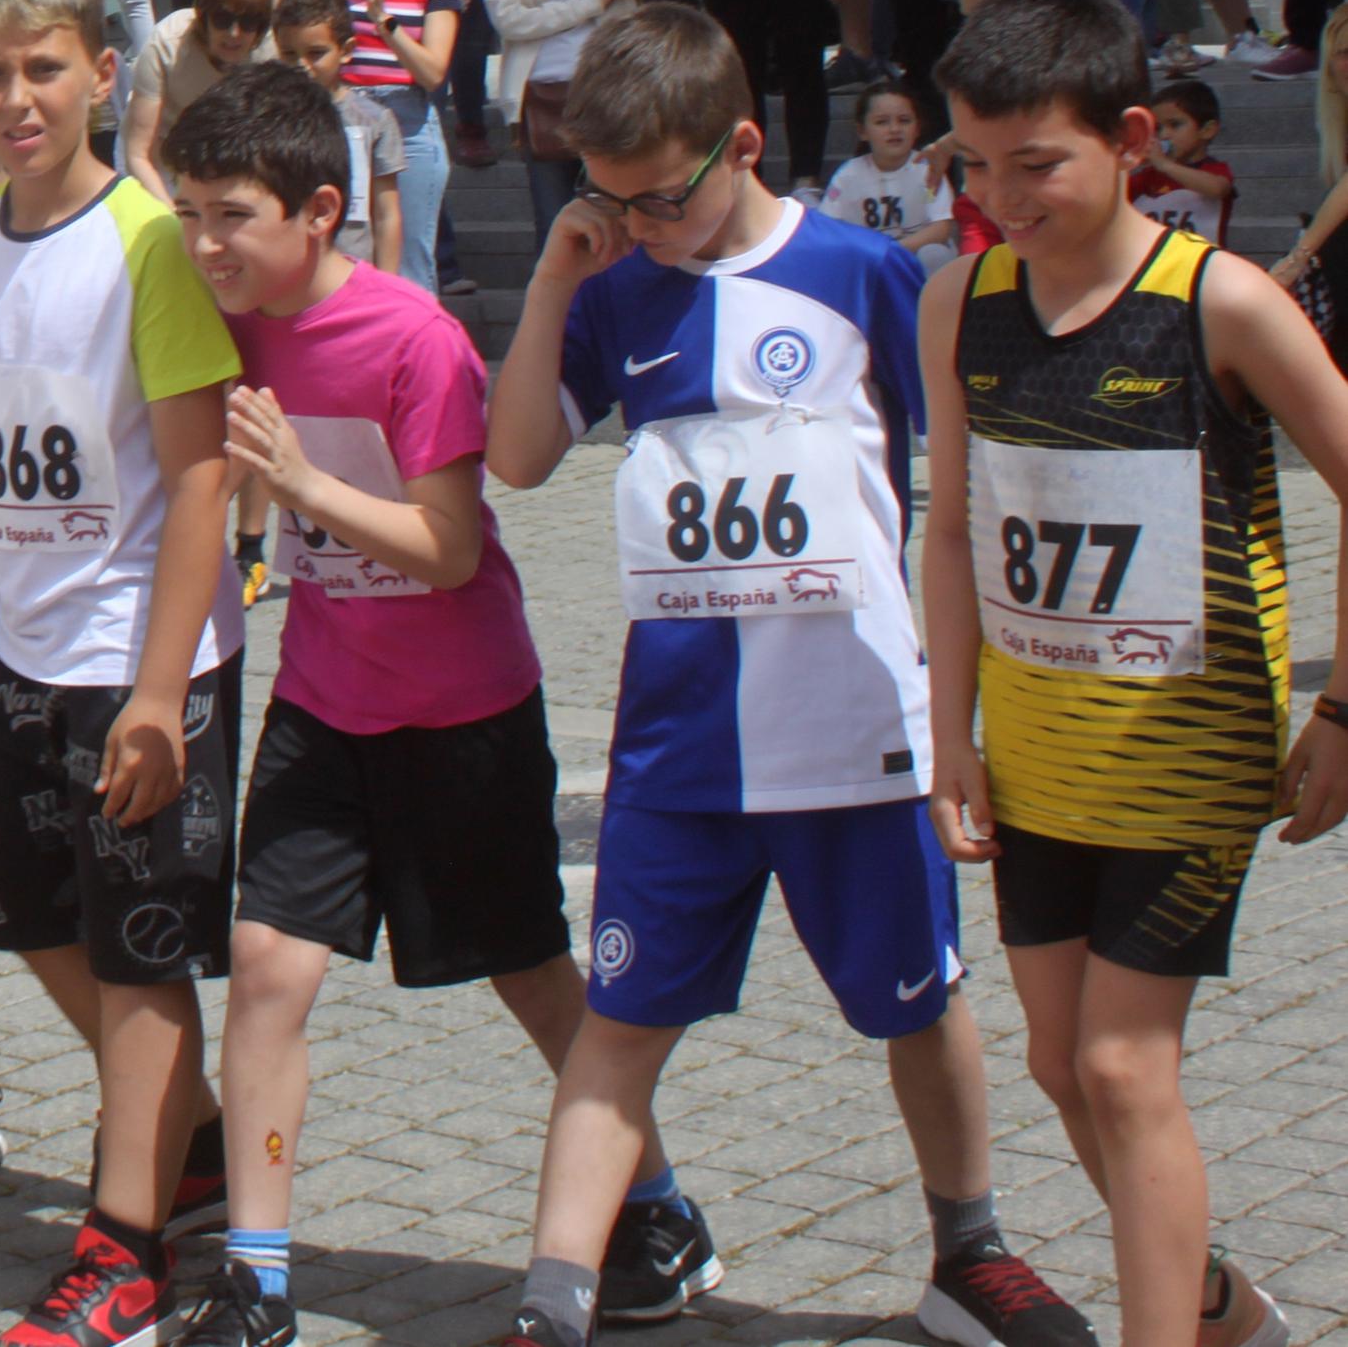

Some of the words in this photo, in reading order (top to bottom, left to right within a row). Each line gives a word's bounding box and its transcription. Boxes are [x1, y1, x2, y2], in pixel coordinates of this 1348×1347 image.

[1103, 379, 1165, 393] SPRINT
[667, 473, 808, 562] 866
[6, 527, 55, 547] España
[1002, 516, 1143, 614] 877
[658, 591, 701, 613] Caja
[706, 589, 777, 611] España
[1001, 628, 1024, 656] Caja
[1031, 638, 1099, 665] España
